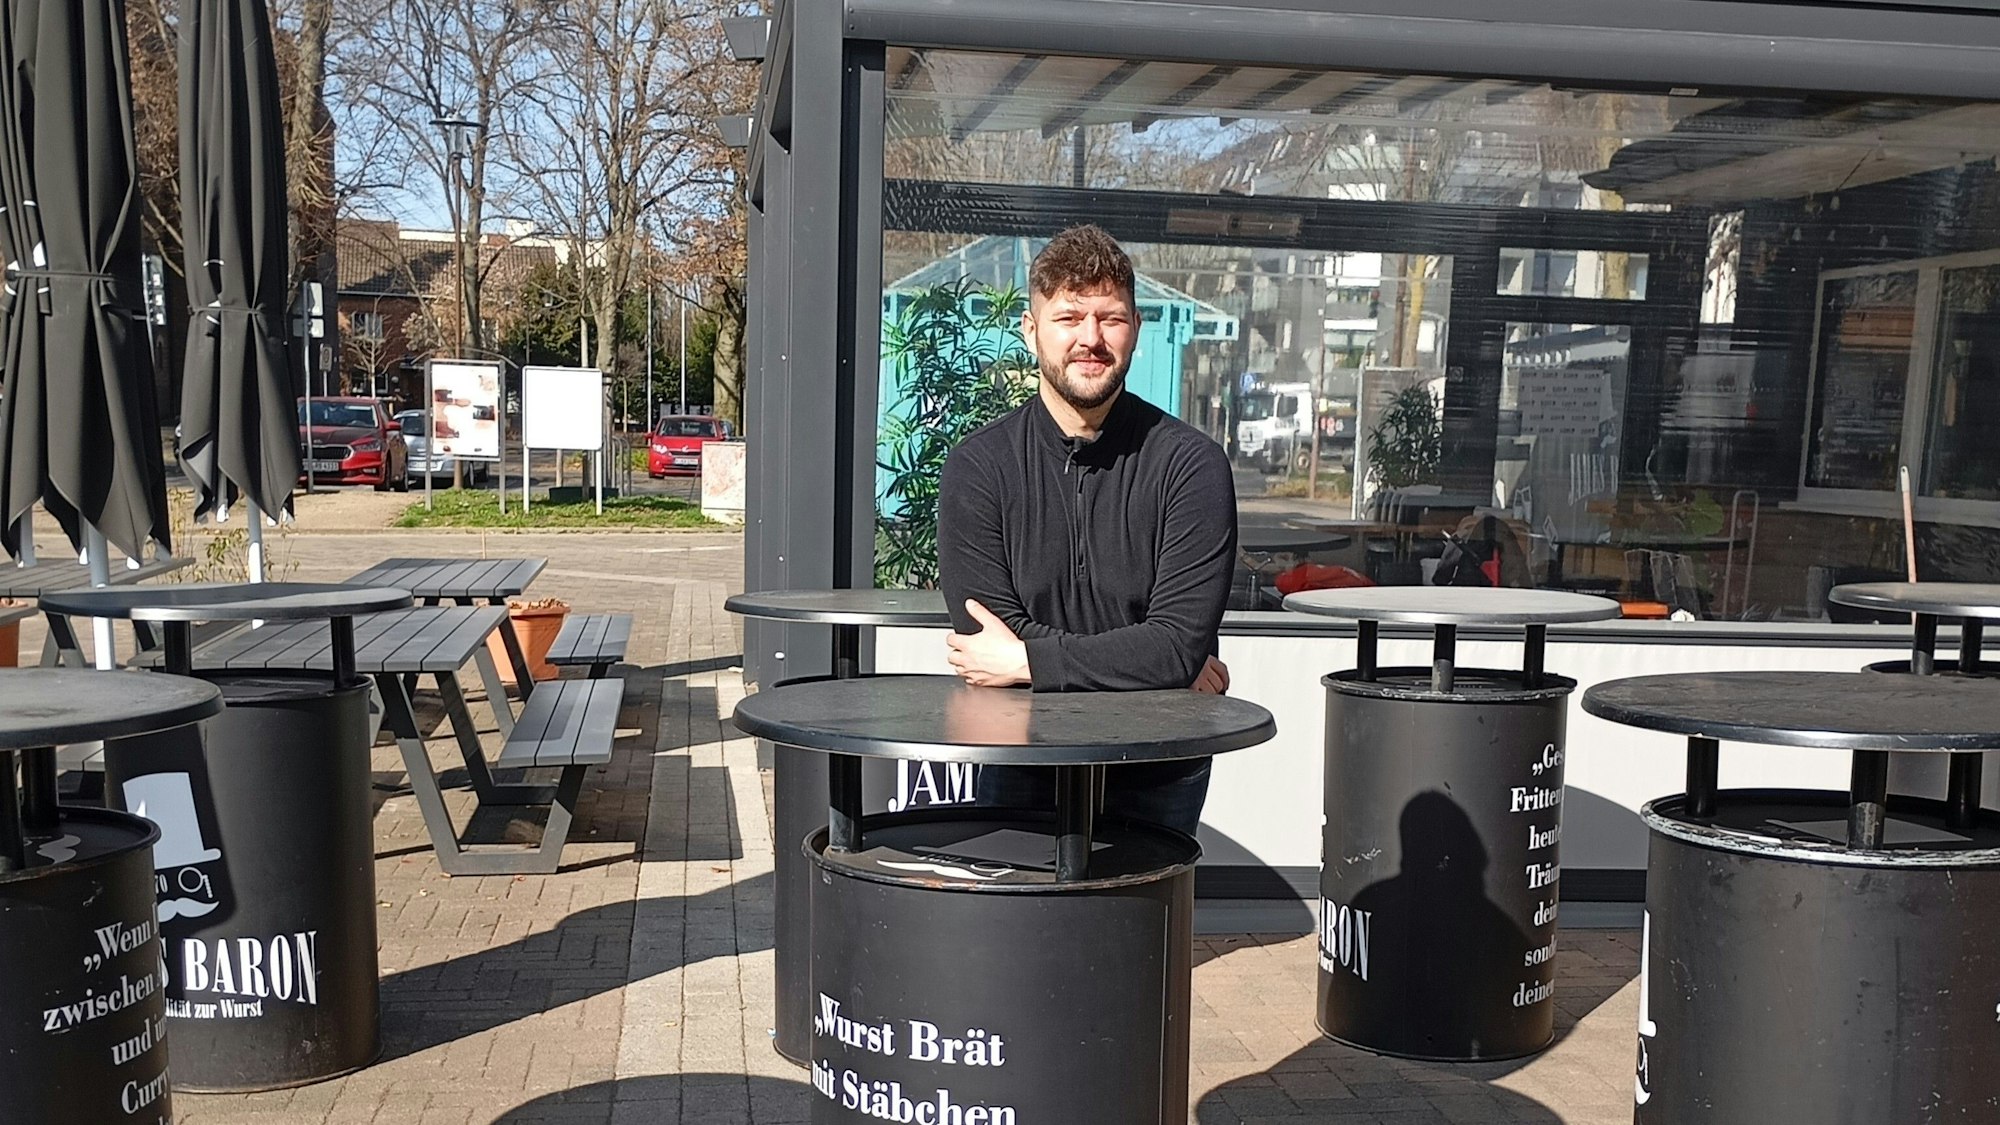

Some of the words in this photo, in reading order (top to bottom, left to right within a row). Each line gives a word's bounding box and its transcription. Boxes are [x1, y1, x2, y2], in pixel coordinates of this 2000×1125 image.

[888, 758, 976, 813] JAM
[83, 918, 151, 974] „Wenn
[183, 930, 317, 1005] BARON
[1320, 895, 1372, 982] RON
[43, 974, 154, 1032] zwischen
[165, 998, 191, 1019] lität
[194, 1002, 218, 1019] zur
[220, 997, 264, 1018] Wurst
[814, 991, 896, 1057] „Wurst
[908, 1019, 1005, 1067] Brät
[111, 1017, 152, 1066] und
[812, 1059, 836, 1100] mit
[842, 1069, 1016, 1125] Stäbchen
